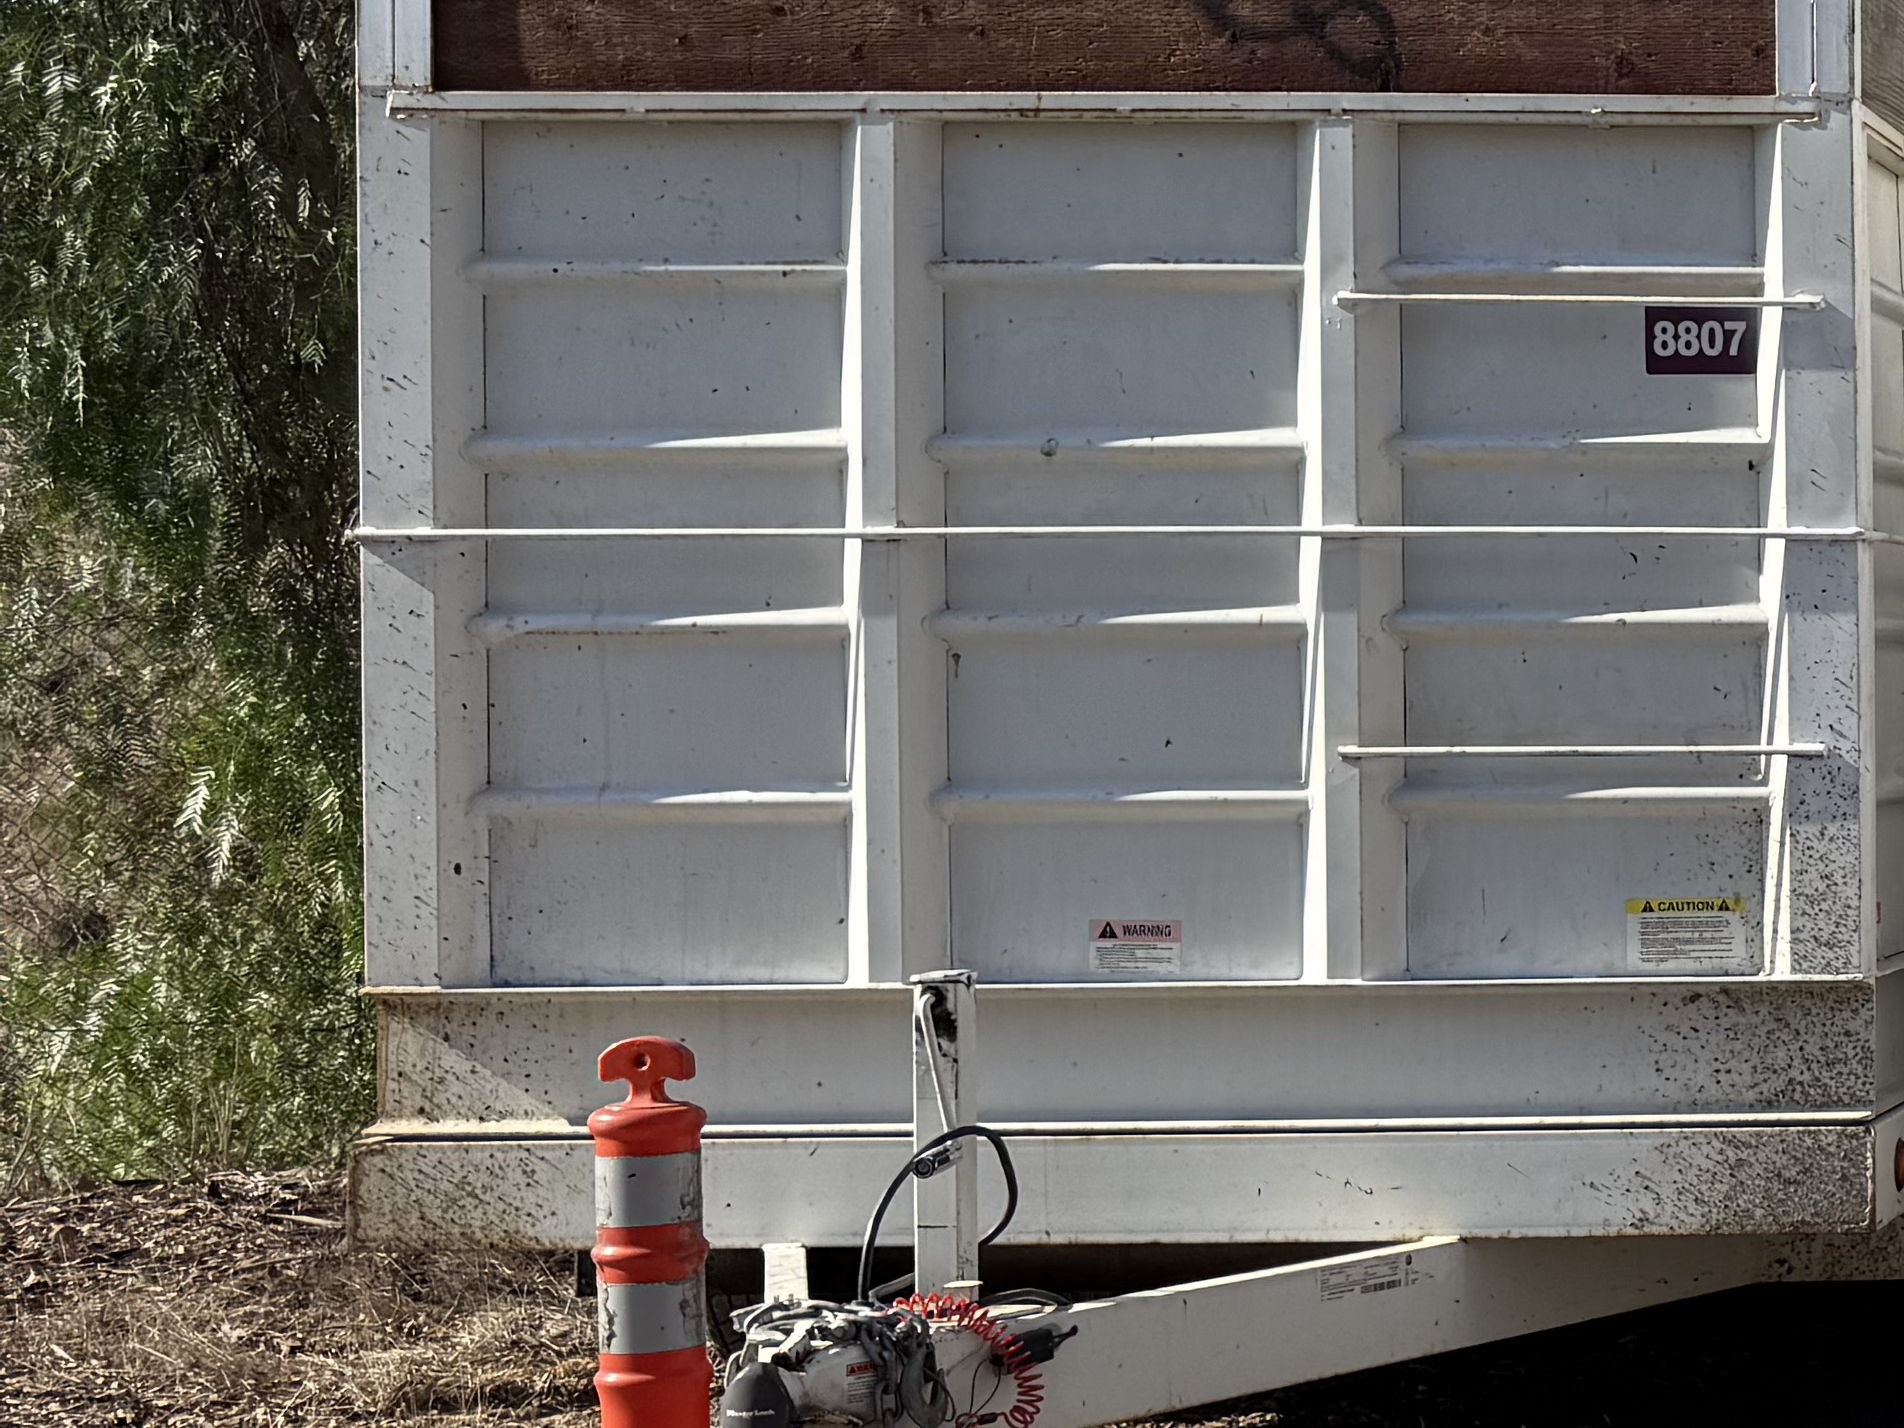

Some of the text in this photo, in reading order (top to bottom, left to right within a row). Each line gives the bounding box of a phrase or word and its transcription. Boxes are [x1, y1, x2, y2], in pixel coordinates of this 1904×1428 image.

[1653, 320, 1747, 357] 8807
[1658, 901, 1714, 912] CAUTION
[1122, 924, 1172, 938] WARNING
